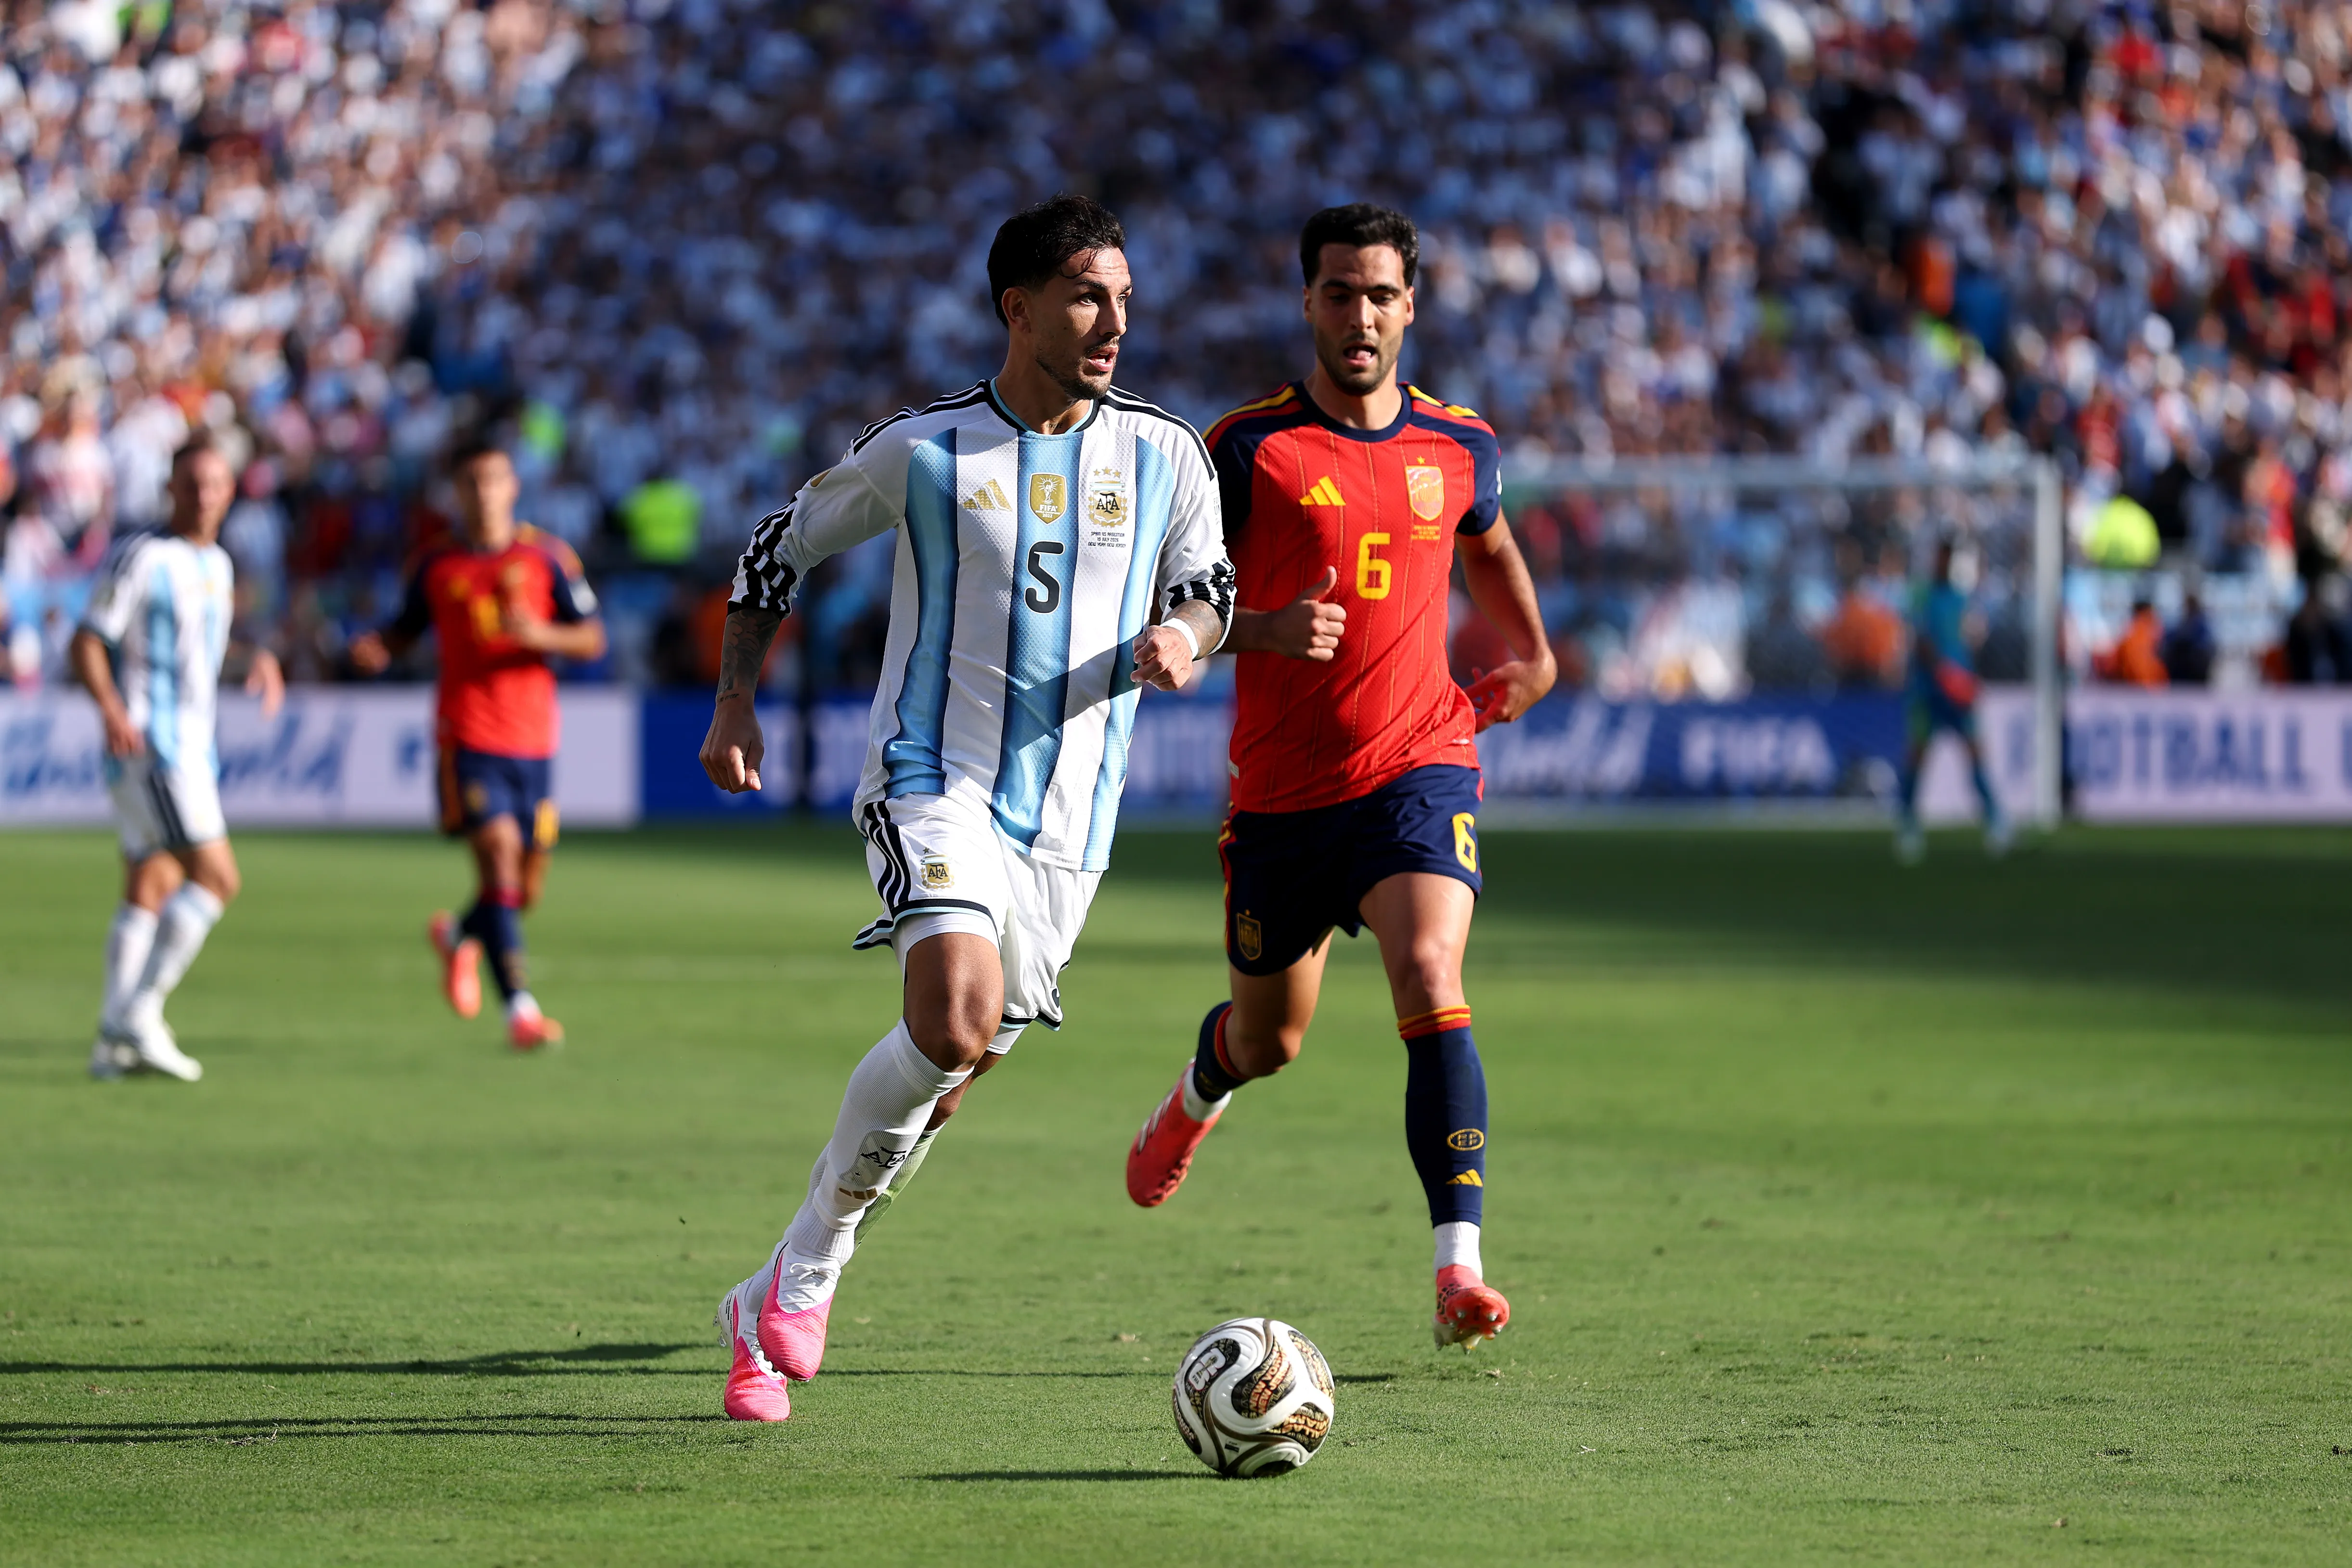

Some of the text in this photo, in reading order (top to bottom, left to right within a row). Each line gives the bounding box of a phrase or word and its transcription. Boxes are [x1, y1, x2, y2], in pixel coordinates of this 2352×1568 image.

[1096, 492, 1120, 514] AFA
[1025, 540, 1065, 614] 5
[1356, 532, 1392, 600] 6
[1679, 713, 1834, 790] FIFA
[2005, 713, 2308, 792] FOTBALL
[928, 864, 948, 880] AFA
[1452, 812, 1476, 873] 6
[1249, 1380, 1267, 1410] NEW
